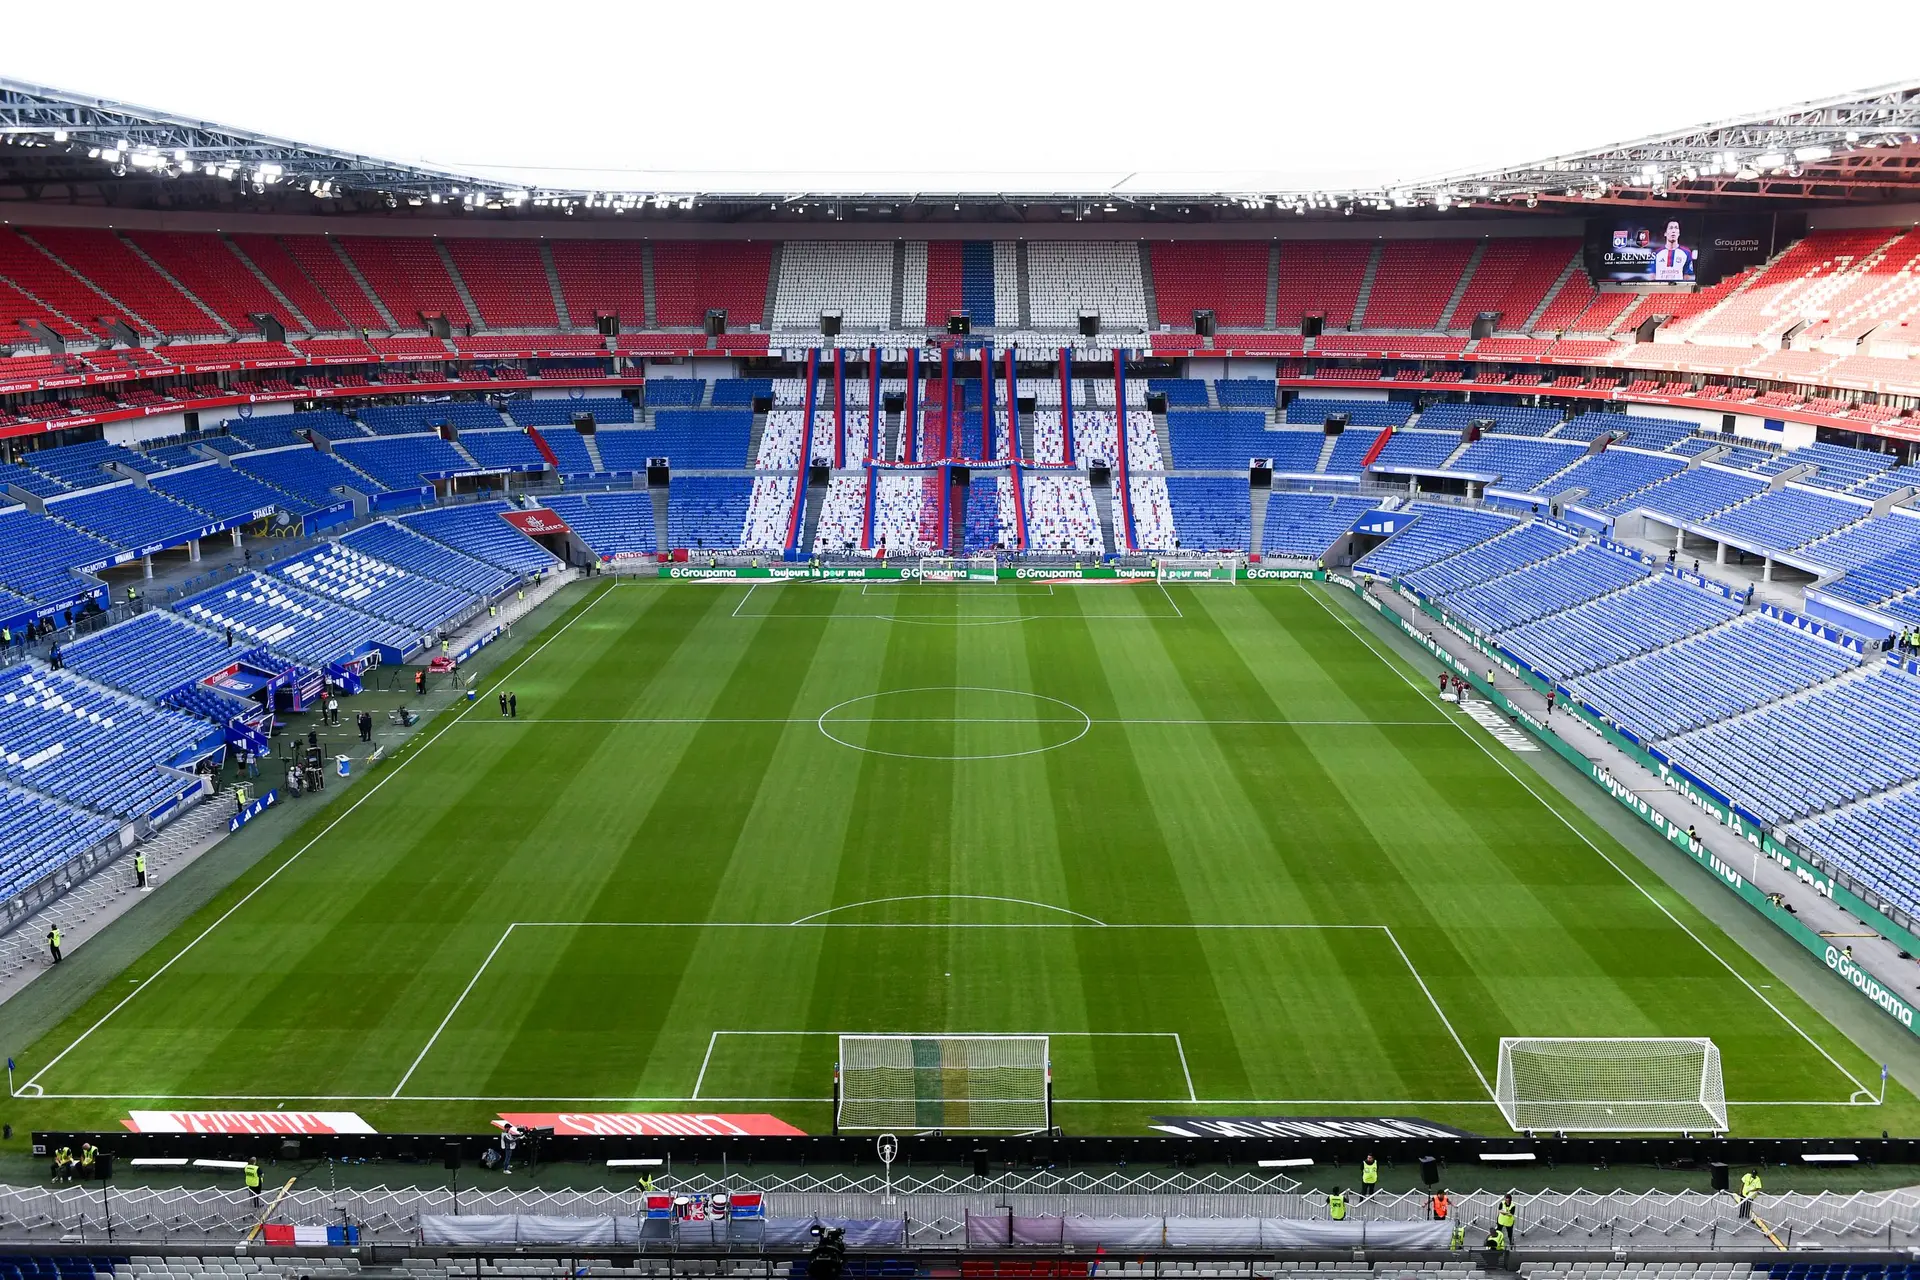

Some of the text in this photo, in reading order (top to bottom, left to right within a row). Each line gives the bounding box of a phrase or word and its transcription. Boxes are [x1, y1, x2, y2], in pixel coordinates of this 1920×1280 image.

[1715, 238, 1758, 248] Groupama
[1604, 252, 1657, 261] OL RENNES
[786, 349, 834, 362] BD
[970, 348, 1005, 362] KP
[1015, 348, 1072, 362] IRAG
[44, 379, 64, 387] Groupama
[253, 505, 274, 520] STANLEY
[521, 523, 564, 534] Emirates
[91, 560, 108, 572] MOTOR
[680, 569, 736, 578] Groupama
[769, 568, 865, 578] Toujours là pour moi
[911, 569, 967, 579] Groupama
[1027, 569, 1083, 579] Groupama
[1115, 569, 1156, 579] Toujours
[1167, 570, 1191, 579] pour
[1194, 569, 1211, 578] moi
[1257, 569, 1313, 580] Groupama
[37, 600, 74, 618] Emirates Emirates
[1659, 763, 1722, 822] Toujours
[1728, 811, 1743, 836] là
[1838, 957, 1913, 1028] Groupama
